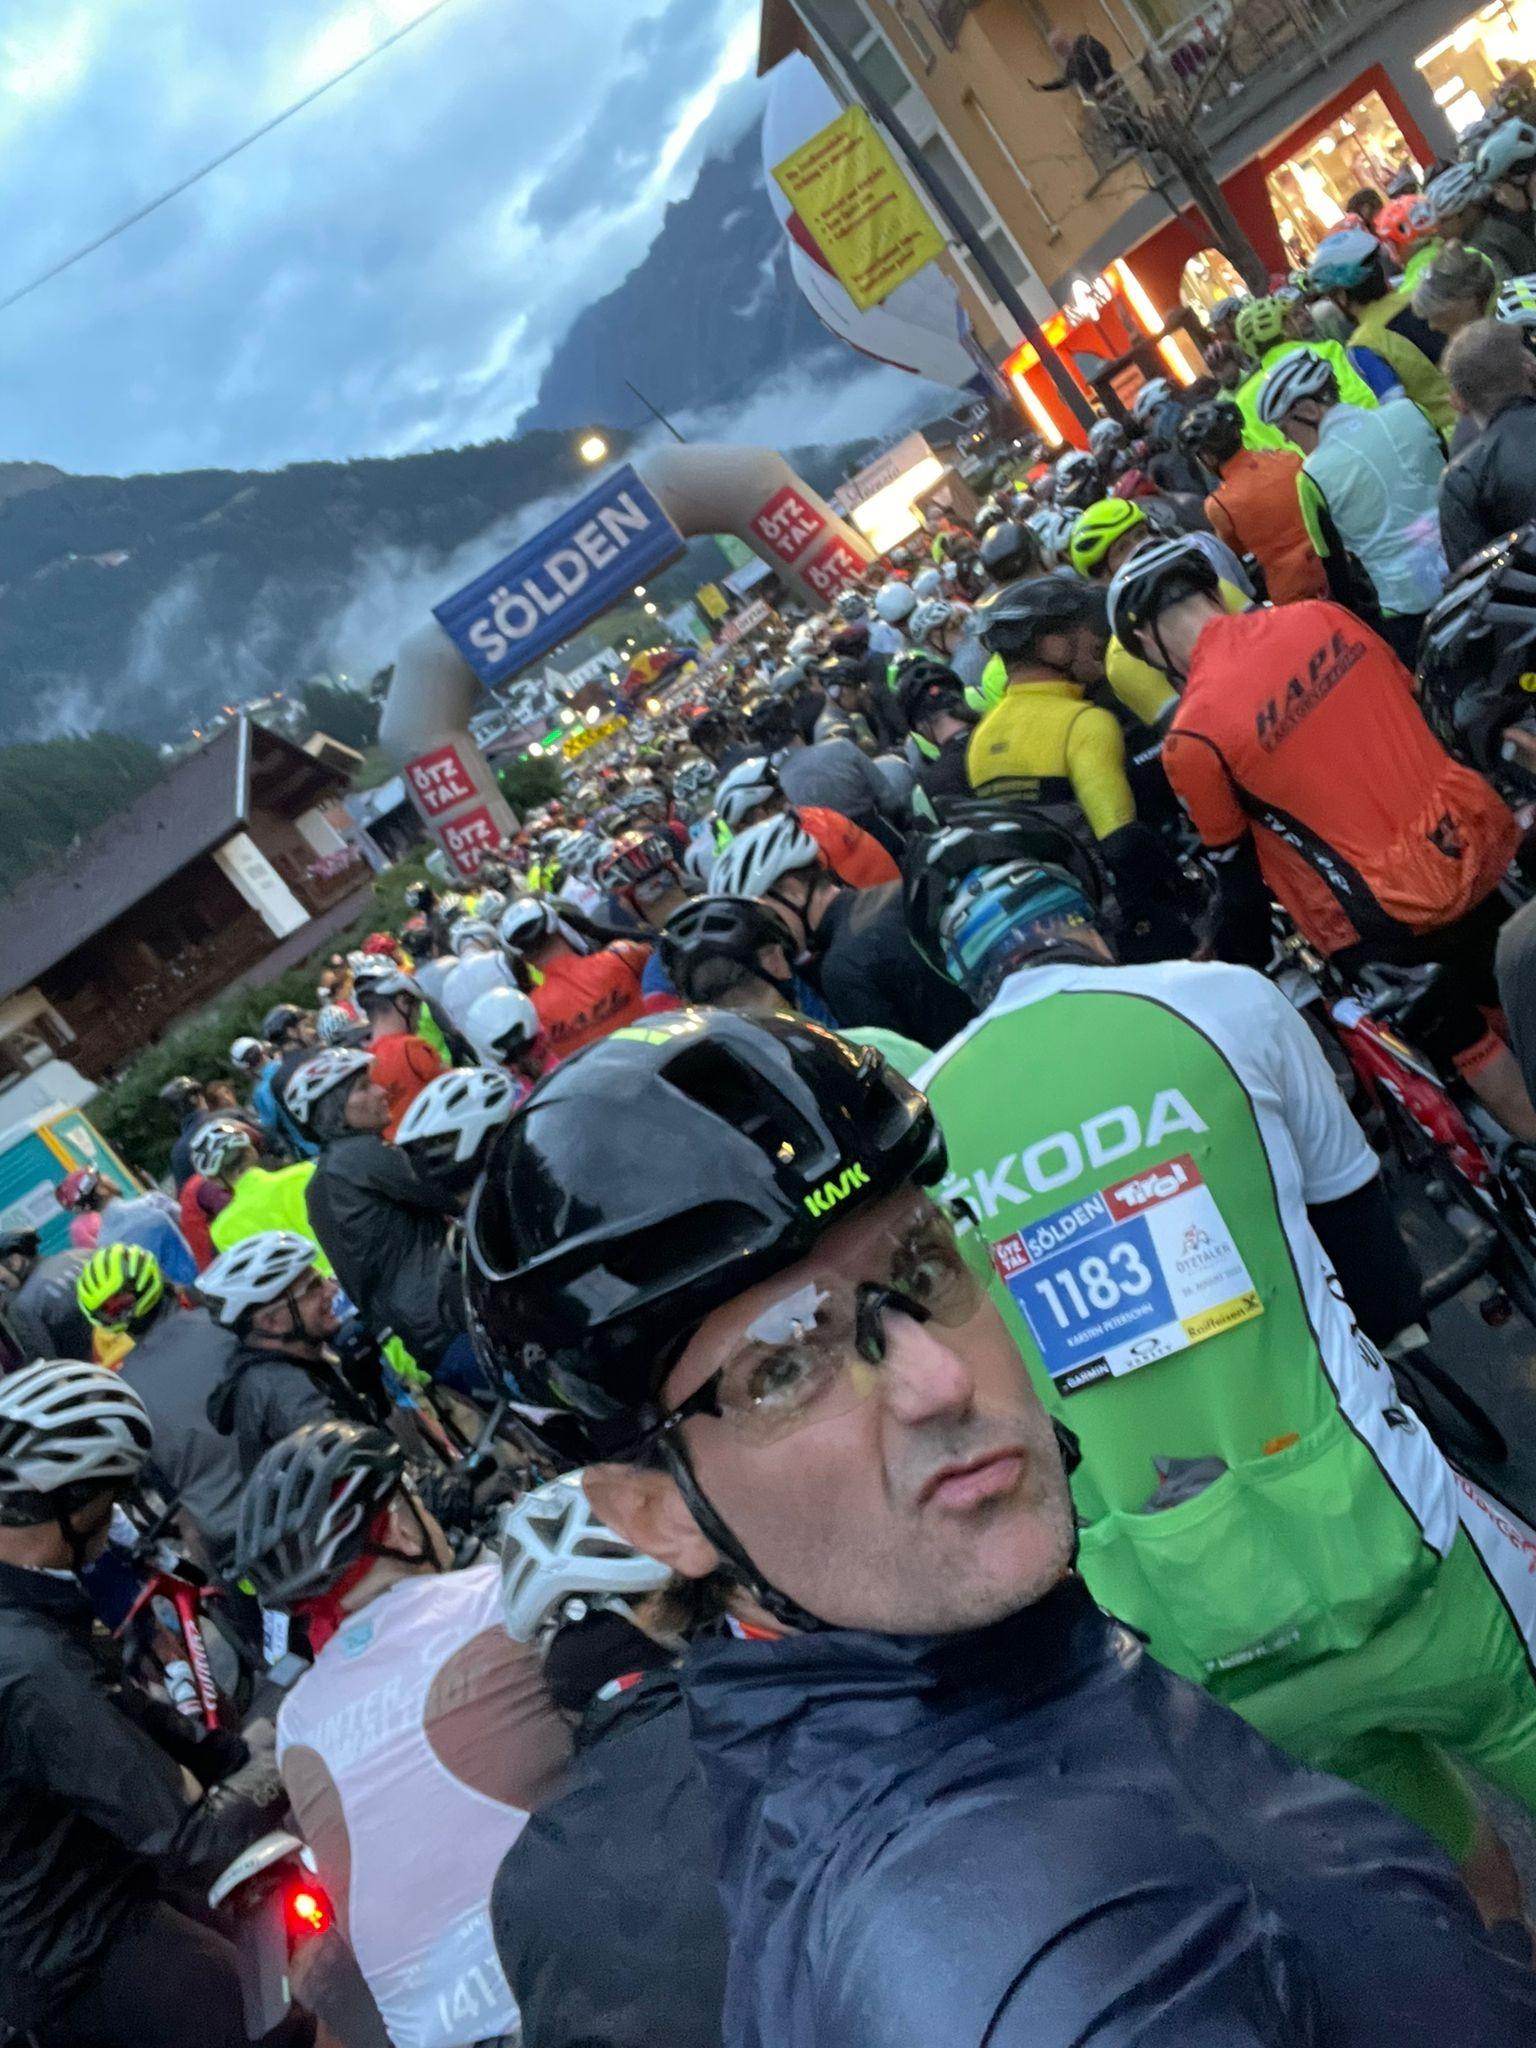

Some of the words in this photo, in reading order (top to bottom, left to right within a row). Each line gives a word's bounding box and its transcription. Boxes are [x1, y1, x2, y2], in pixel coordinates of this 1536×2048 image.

[758, 497, 805, 540] ÖTZ
[776, 518, 820, 554] TAL
[469, 491, 650, 663] SÖLDEN
[412, 757, 459, 790] ÖTZ
[423, 780, 470, 809] TAL
[1114, 1163, 1189, 1207] Tirol
[1028, 1197, 1105, 1258] SÖLDEN
[1034, 1241, 1153, 1329] 1183
